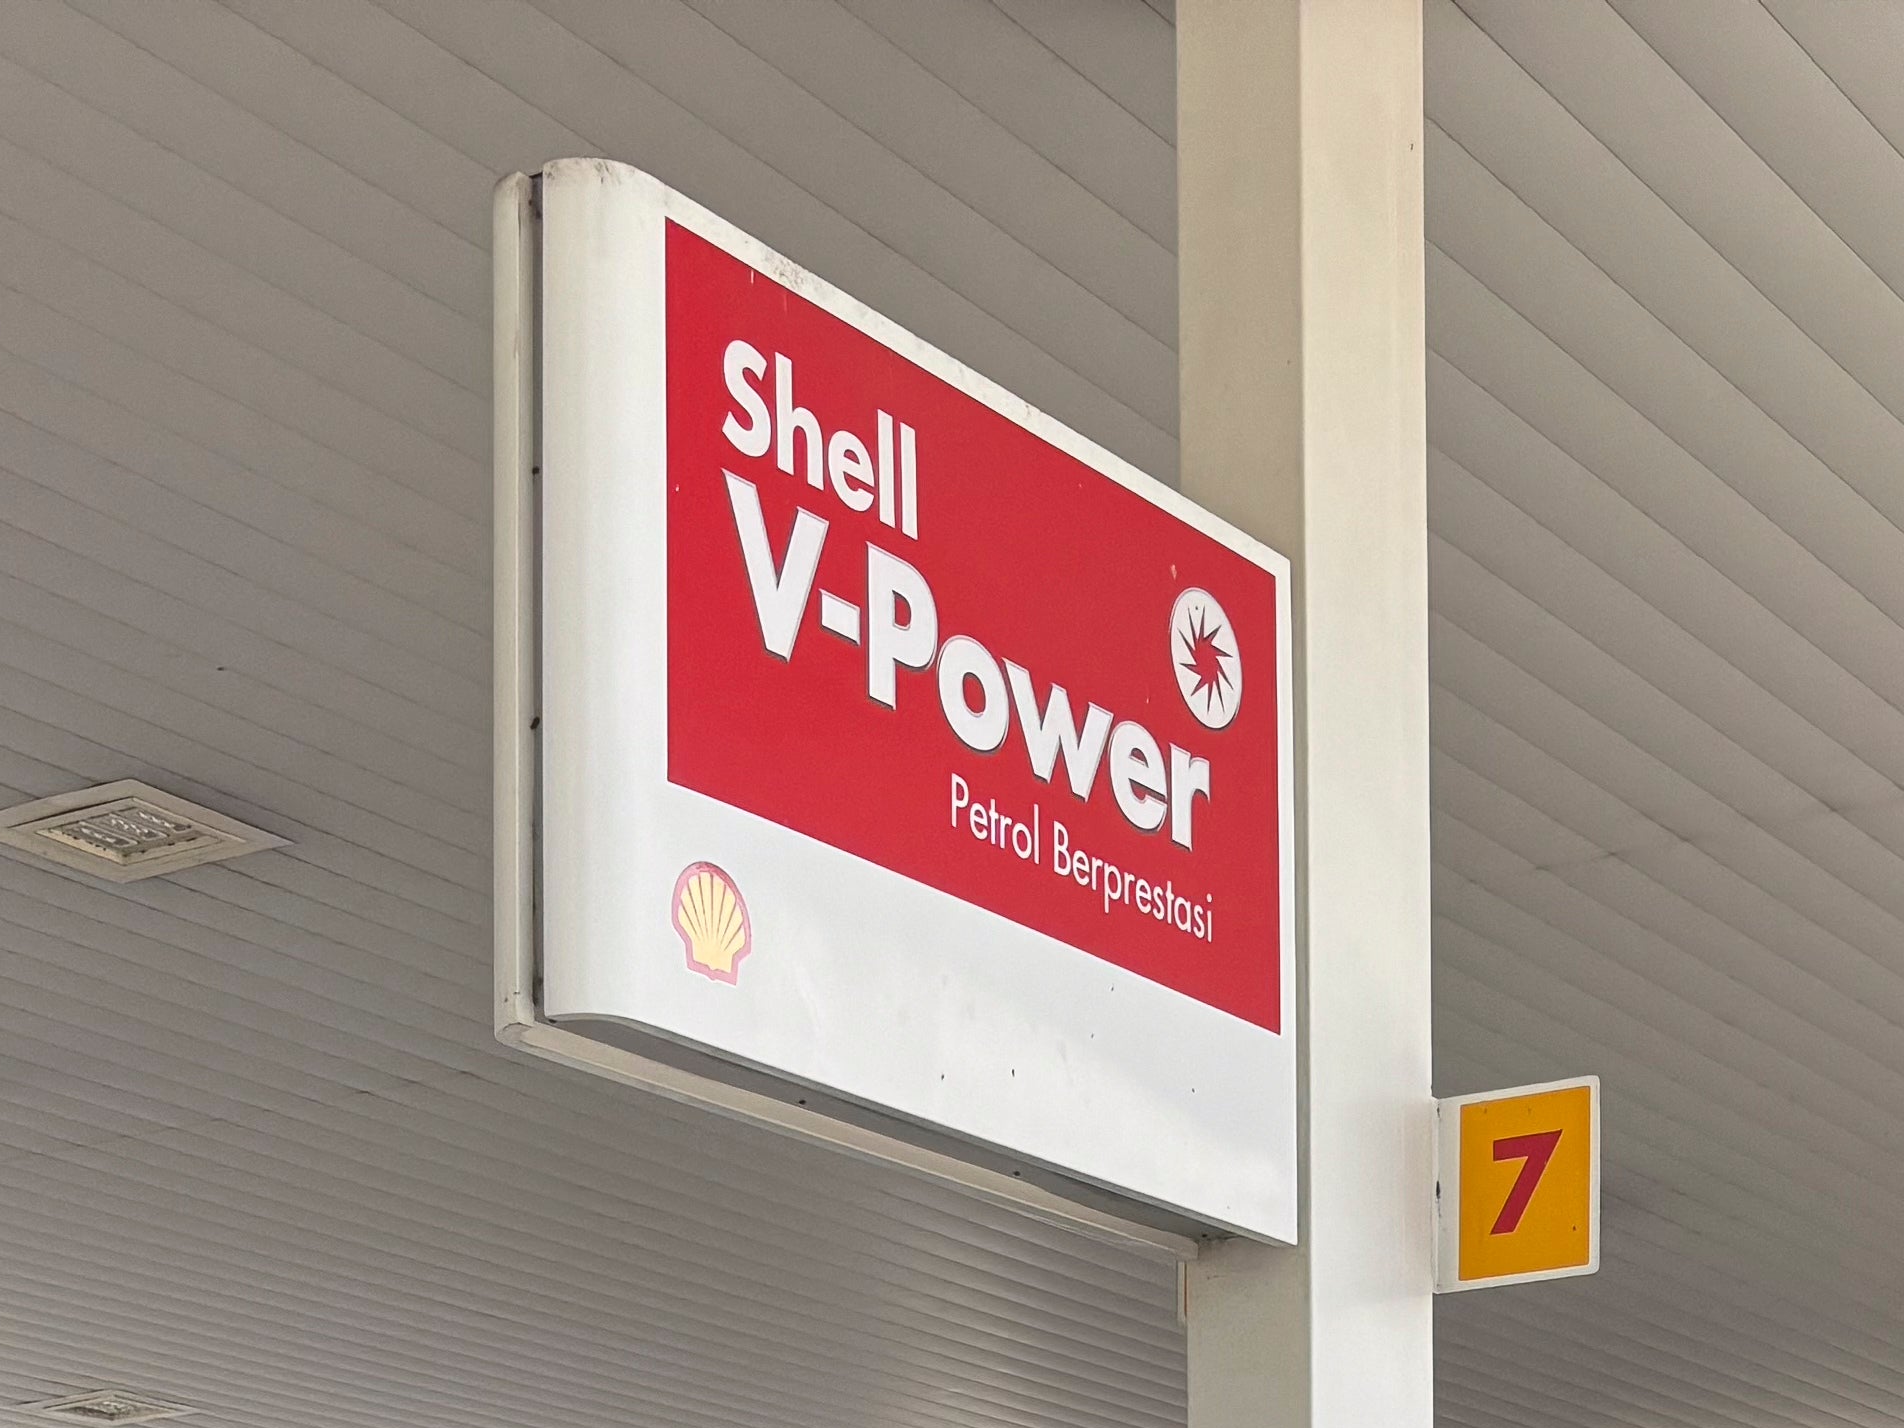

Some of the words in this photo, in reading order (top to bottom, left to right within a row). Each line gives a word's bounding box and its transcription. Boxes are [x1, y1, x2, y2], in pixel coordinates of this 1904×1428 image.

[723, 340, 918, 541] Shell
[723, 469, 1211, 850] V-Power
[950, 774, 1040, 864] Petrol
[1052, 820, 1215, 943] Berprestasi
[1491, 1127, 1562, 1234] 7
